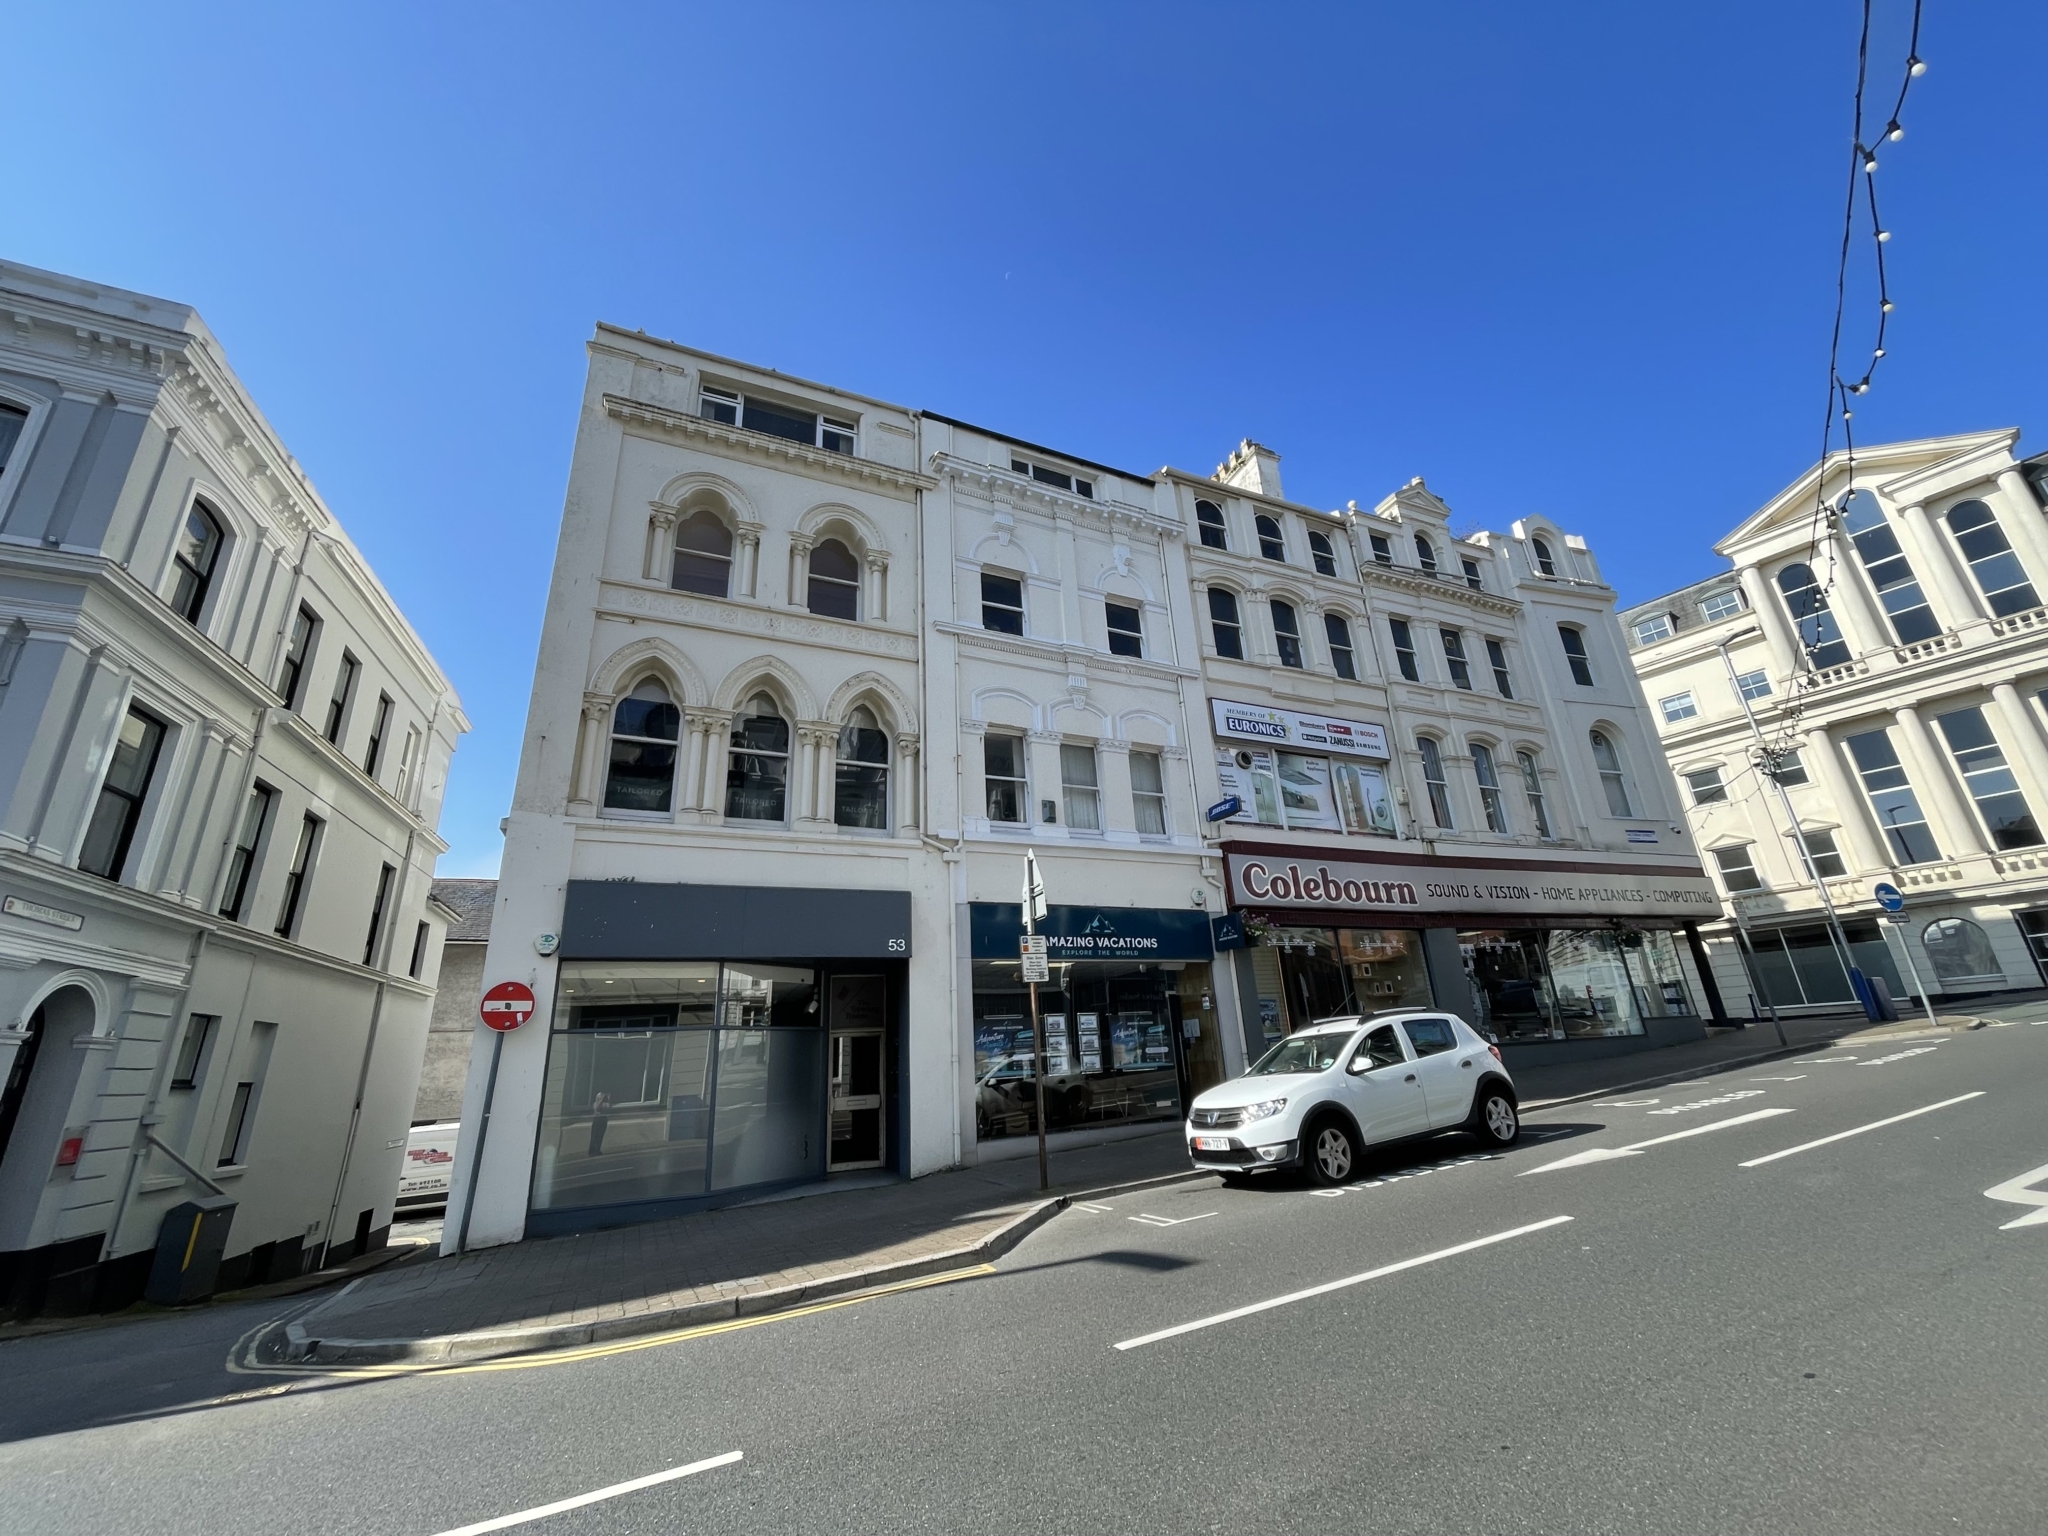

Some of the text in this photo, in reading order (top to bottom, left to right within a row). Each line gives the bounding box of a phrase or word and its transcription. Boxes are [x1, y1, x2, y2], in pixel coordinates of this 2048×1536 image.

[1226, 708, 1257, 717] MEMBERS
[1228, 718, 1285, 737] EURONICS
[616, 785, 663, 796] TAILORED
[735, 796, 776, 806] TAILORED
[842, 805, 879, 816] TAILORED
[1210, 801, 1234, 816] BOSE
[1242, 862, 1419, 906] Colebourn
[1426, 884, 1469, 898] SOUND
[1474, 885, 1483, 898] &
[1485, 886, 1530, 899] VISION
[1541, 887, 1576, 900] HOME
[1579, 888, 1644, 901] APPLIANCES
[1653, 890, 1713, 903] COMPUTING
[888, 939, 905, 951] 53
[1096, 938, 1158, 948] VACATIONS
